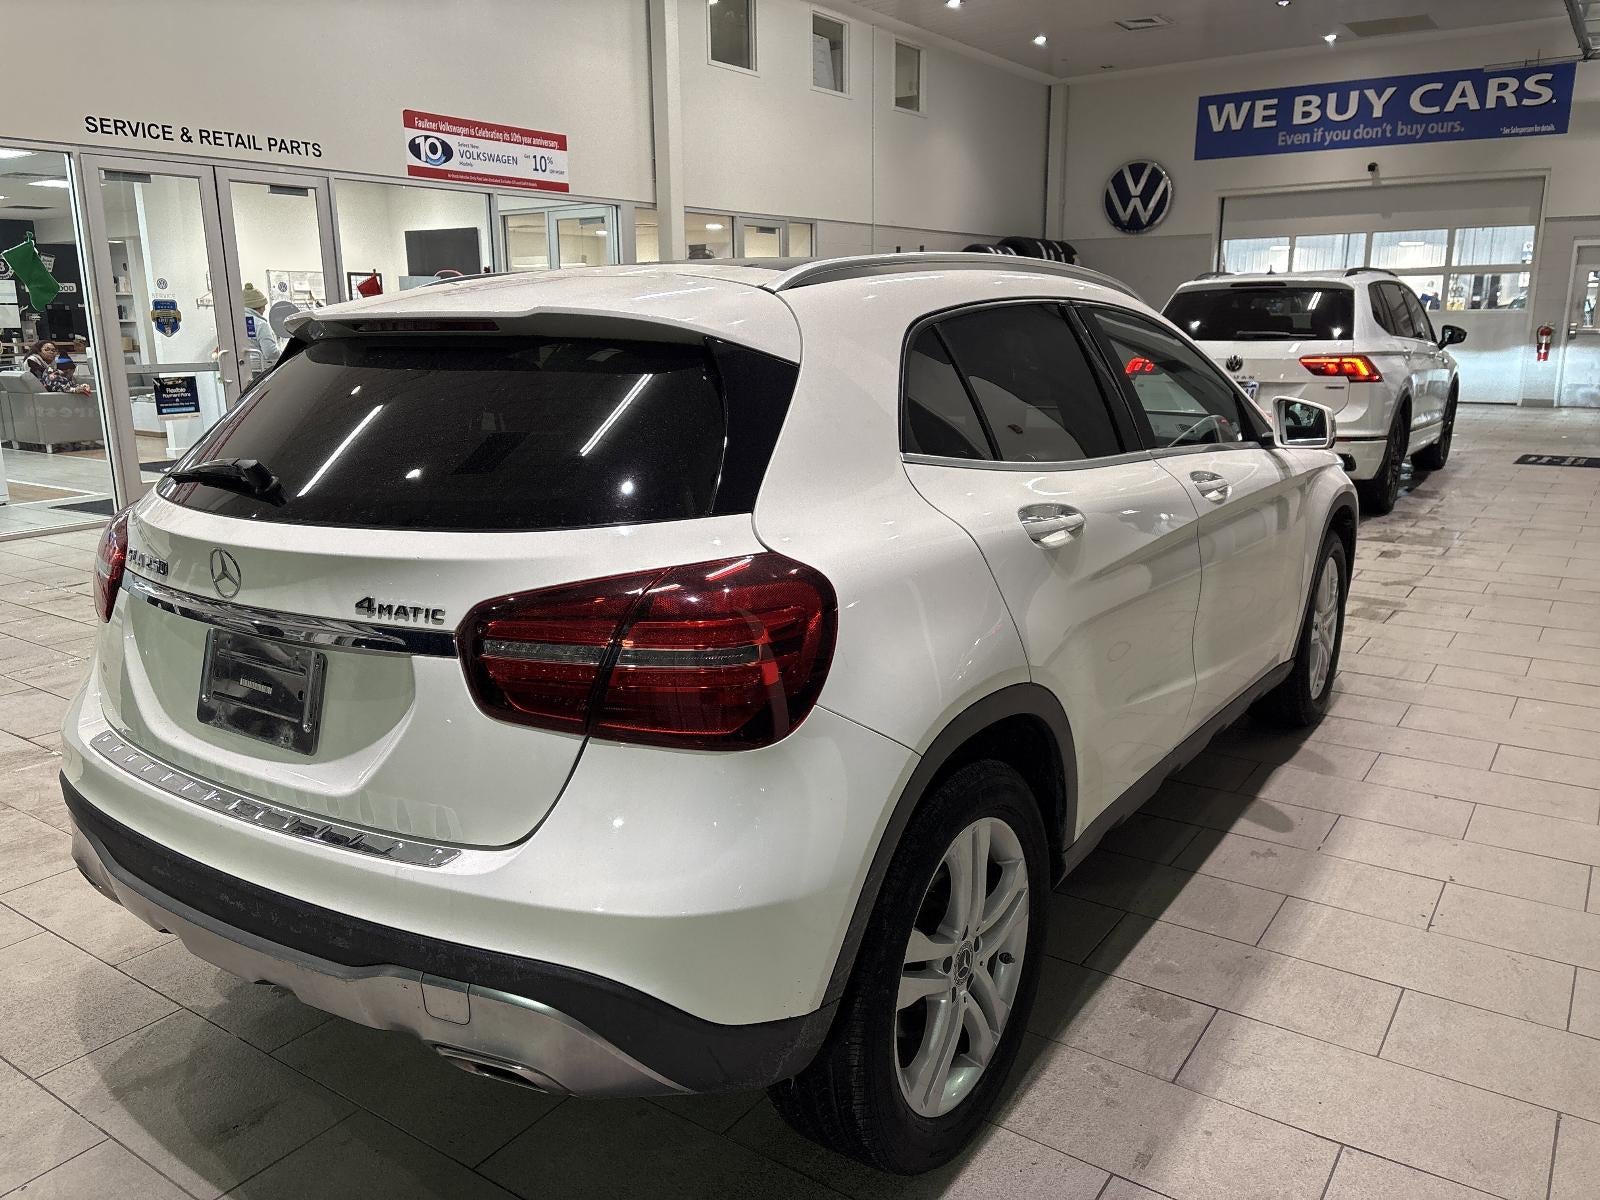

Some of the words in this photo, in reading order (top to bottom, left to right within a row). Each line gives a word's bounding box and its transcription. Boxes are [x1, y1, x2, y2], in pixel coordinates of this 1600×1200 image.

[1207, 98, 1279, 132] WE
[1292, 86, 1397, 125] BUY
[1409, 72, 1557, 115] CARS.
[84, 115, 175, 141] SERVICE
[180, 126, 194, 143] &
[198, 129, 263, 151] RETAIL
[267, 136, 322, 158] PARTS
[414, 117, 438, 130] Faulkner
[438, 121, 469, 136] Volkswagen
[469, 126, 475, 136] is
[475, 126, 503, 142] Celebrating
[522, 136, 533, 145] year
[1277, 131, 1311, 146] Even
[1313, 128, 1323, 143] if
[1324, 130, 1351, 145] you
[1353, 122, 1392, 140] don't
[1397, 121, 1426, 139] buy
[1427, 120, 1465, 134] ours.
[415, 136, 443, 162] 10
[459, 149, 518, 166] VOLKSWAGEN
[355, 596, 446, 626] 4MATIC
